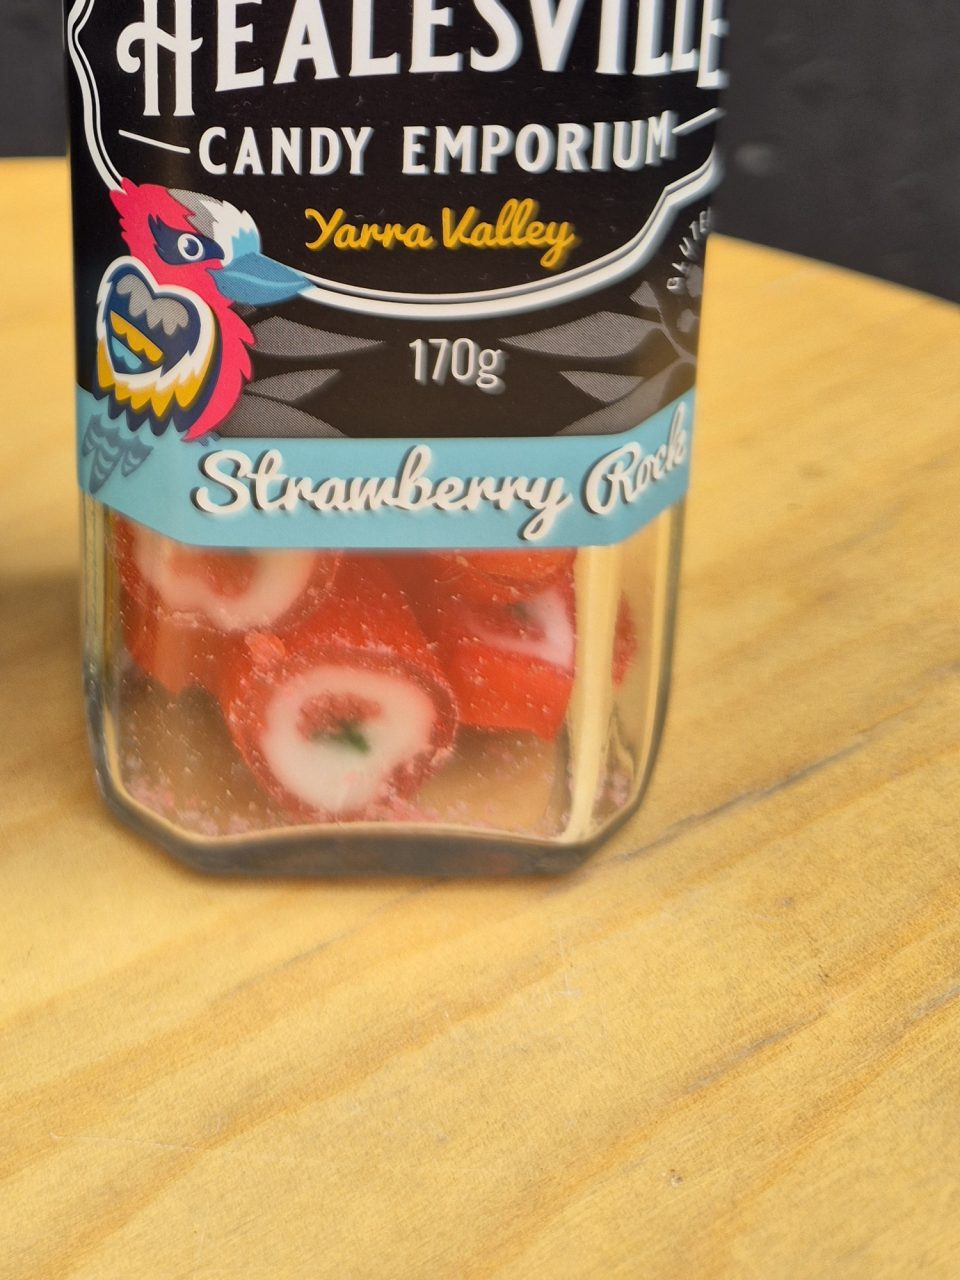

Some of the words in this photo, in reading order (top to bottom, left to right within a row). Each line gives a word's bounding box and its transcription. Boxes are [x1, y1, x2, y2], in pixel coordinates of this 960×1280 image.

[197, 126, 373, 176] CANDY
[401, 110, 675, 175] EMPORIUM
[304, 207, 435, 250] Yarra
[440, 198, 576, 268] Valley
[408, 336, 506, 392] 170g
[190, 446, 570, 542] Strawberry
[583, 402, 689, 516] Rock
